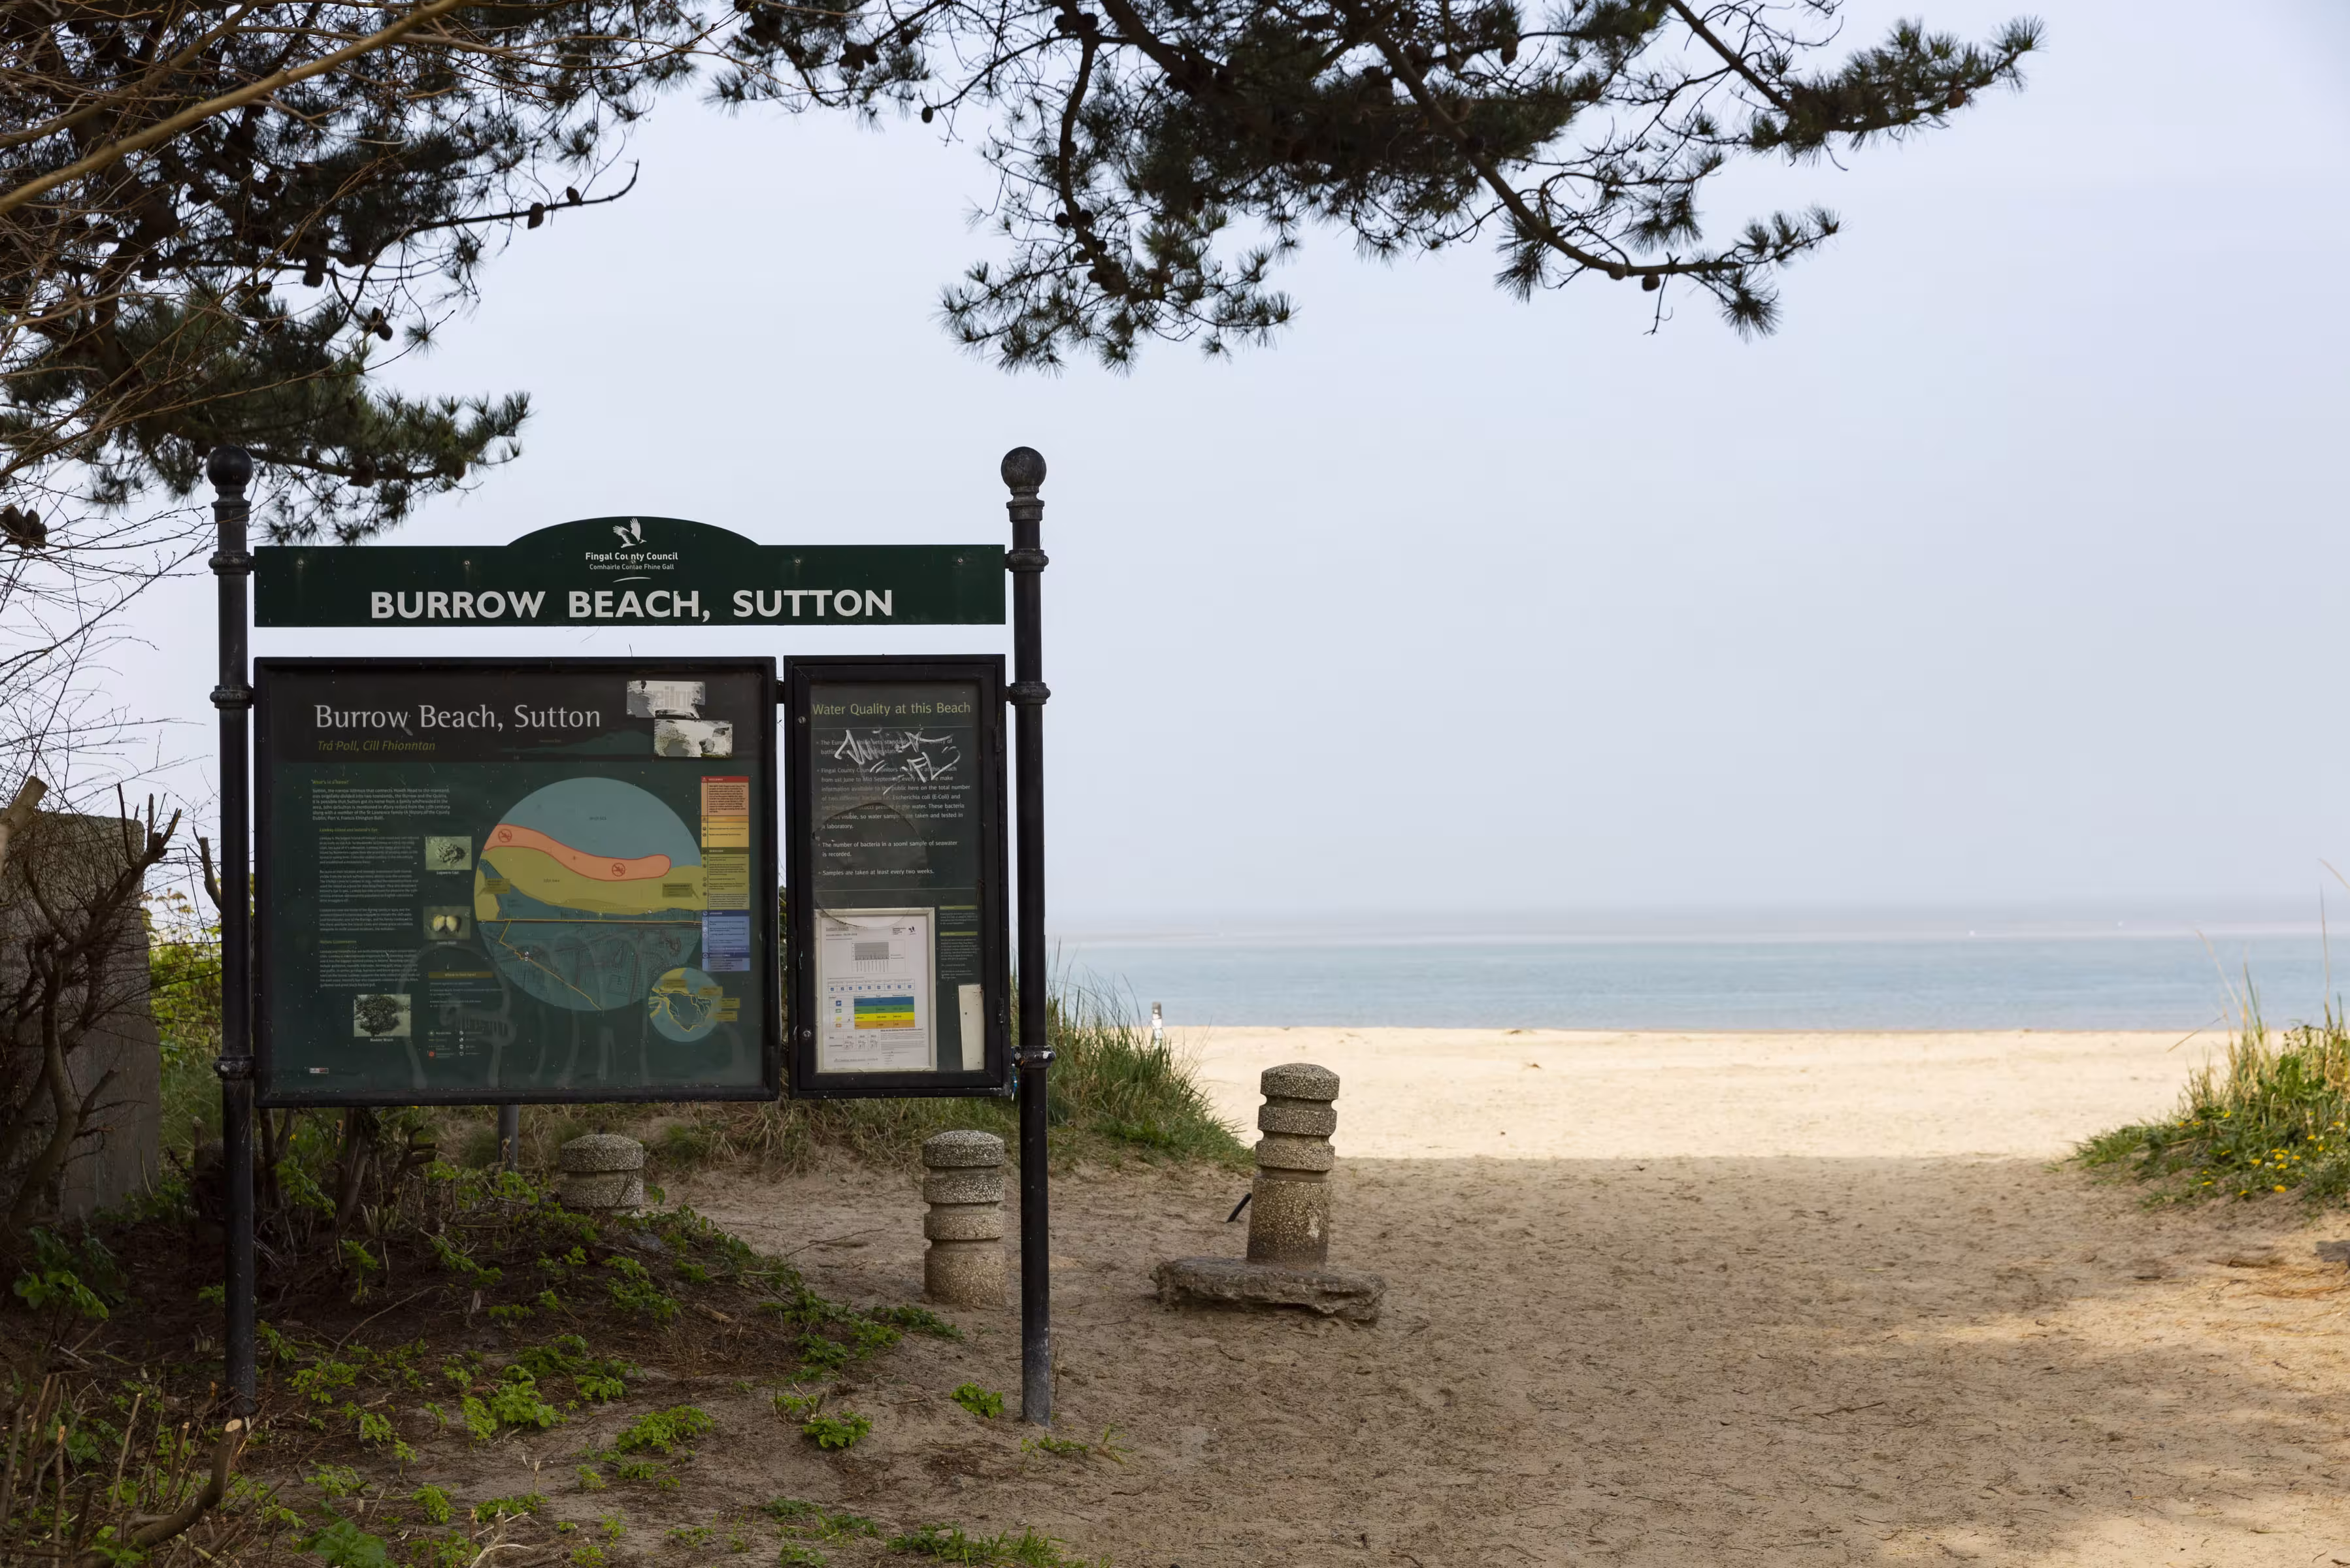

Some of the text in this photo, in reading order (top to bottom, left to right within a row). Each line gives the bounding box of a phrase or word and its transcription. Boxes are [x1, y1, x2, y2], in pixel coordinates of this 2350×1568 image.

[586, 552, 612, 562] Fingal
[371, 589, 893, 623] BURROW BEACH, SUTTON
[812, 702, 971, 717] Water Quality at this Beach
[314, 704, 601, 732] Burrow Beach, Sutton
[318, 740, 435, 751] Trá Poll, Cill Fhionntan
